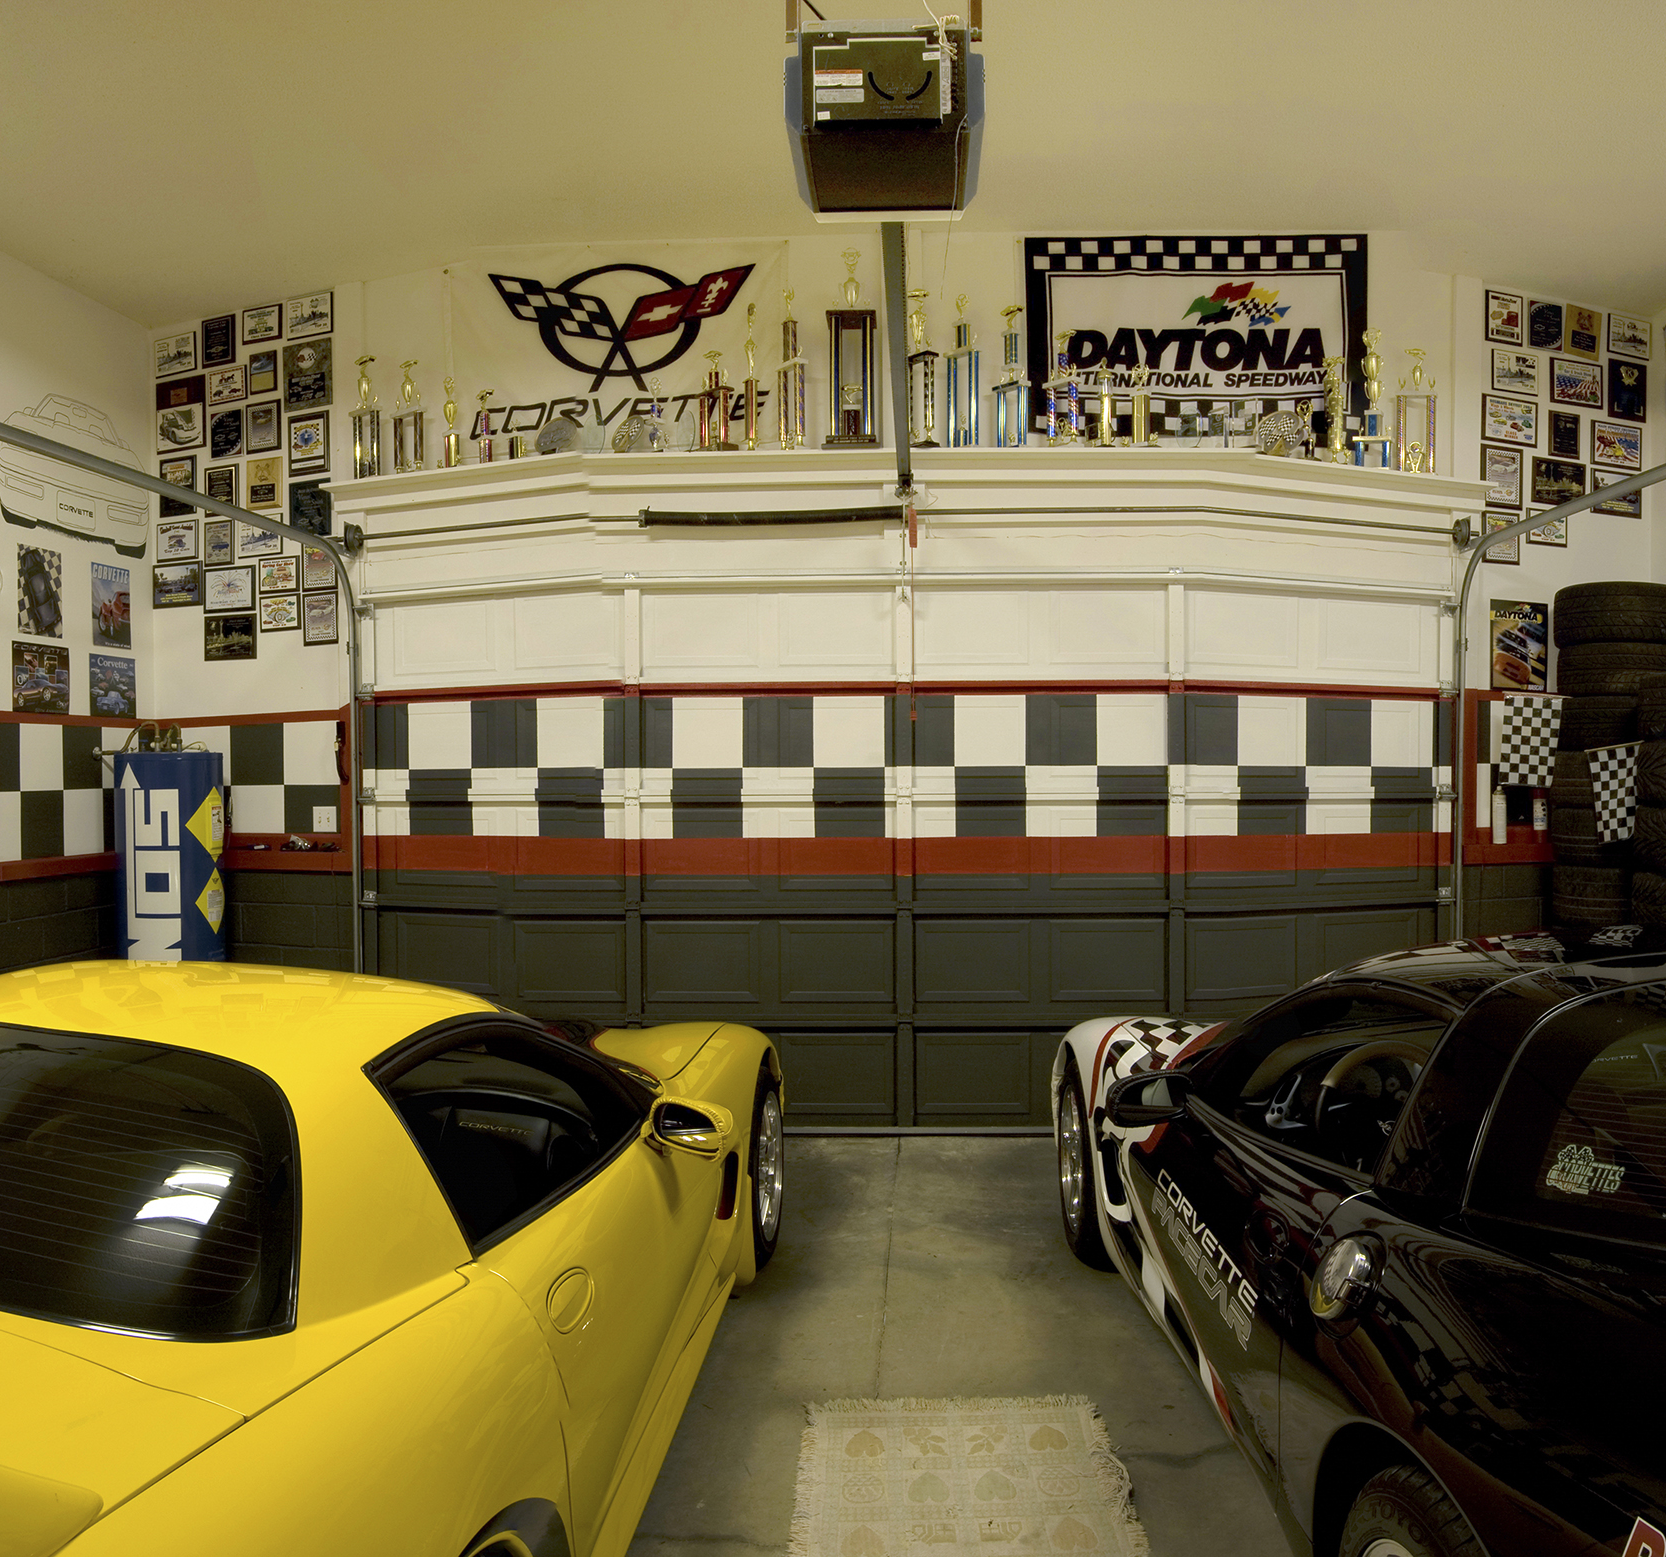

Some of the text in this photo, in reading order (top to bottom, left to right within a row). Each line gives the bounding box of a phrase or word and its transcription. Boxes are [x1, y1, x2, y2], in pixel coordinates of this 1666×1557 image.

[1068, 328, 1326, 371] DAYTONA
[1224, 369, 1328, 388] SPEEDWAY
[470, 390, 771, 440] CORVETTE
[58, 502, 94, 519] CORVETTE
[92, 563, 130, 585] CORVETTE
[1494, 610, 1538, 622] DAYTONA
[13, 643, 68, 656] CORVETTE
[97, 656, 128, 671] Corvette
[126, 787, 182, 961] NOS
[1592, 1054, 1638, 1064] ORVETTE
[1158, 1168, 1259, 1314] CORVETTE
